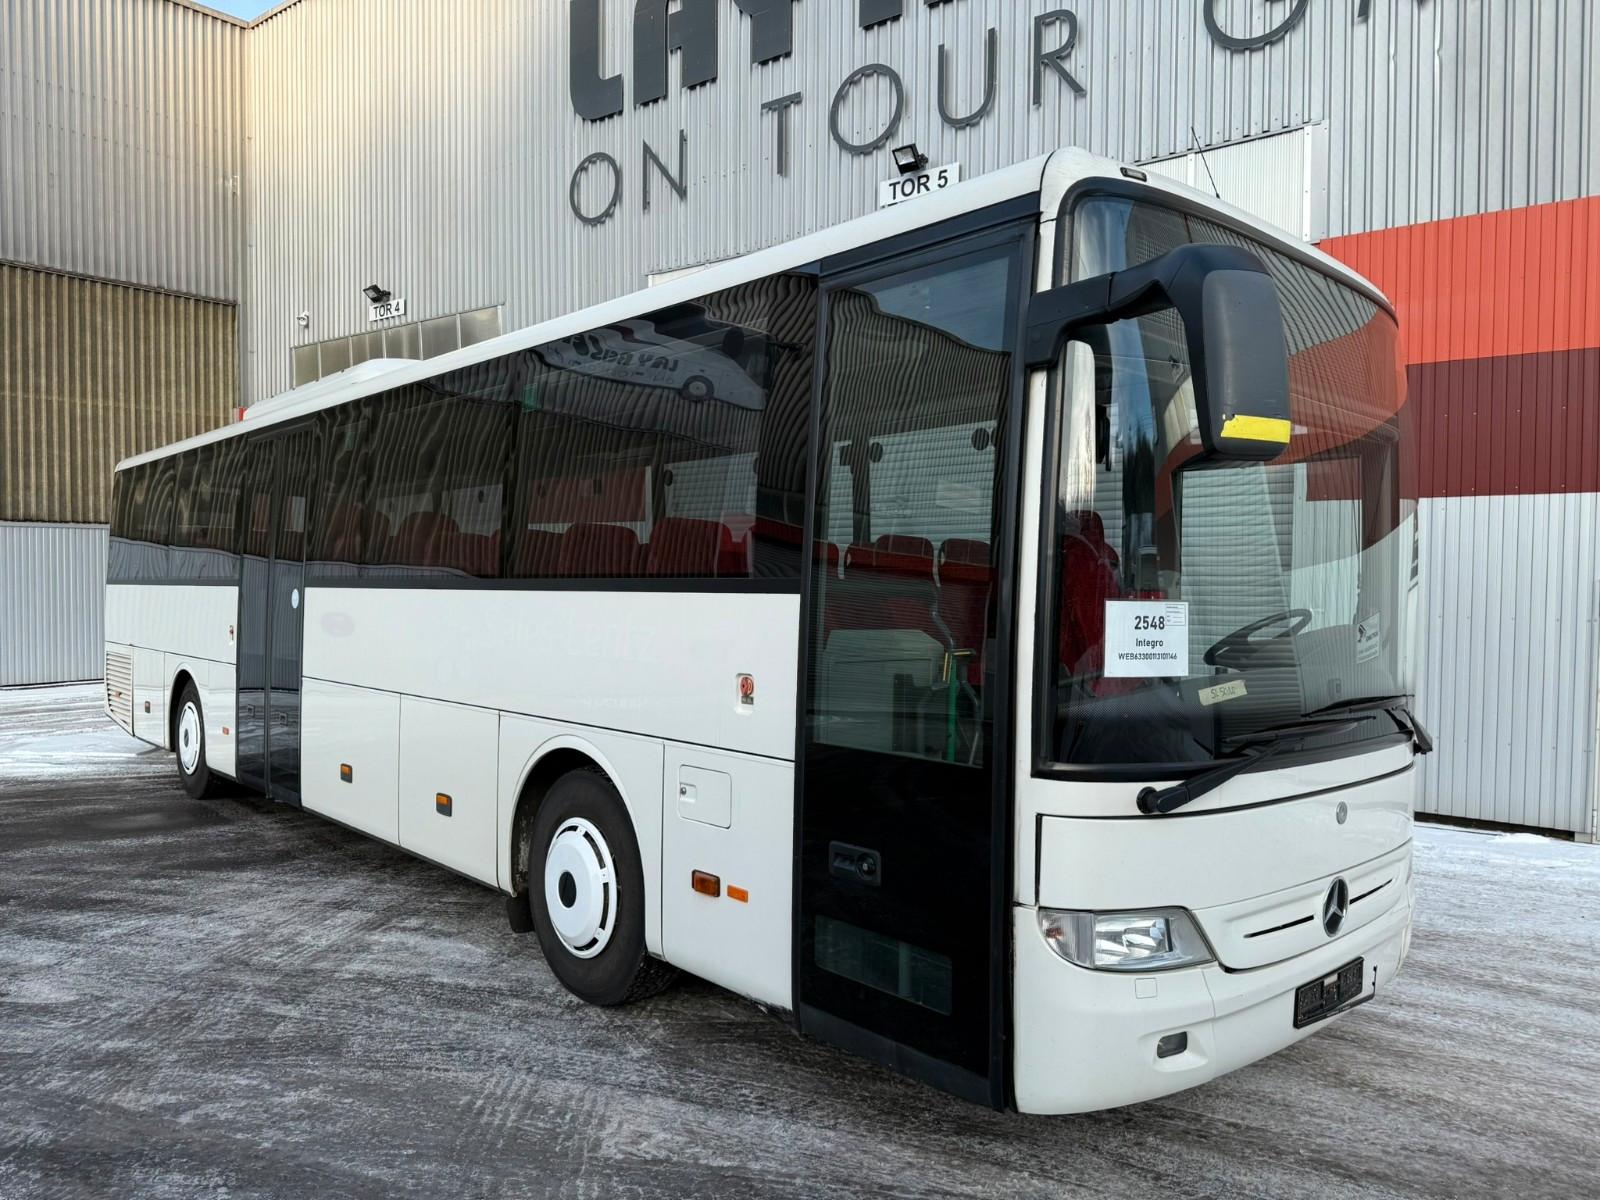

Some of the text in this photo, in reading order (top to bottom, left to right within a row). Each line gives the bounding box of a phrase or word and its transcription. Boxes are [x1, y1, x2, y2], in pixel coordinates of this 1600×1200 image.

[570, 9, 1086, 225] ON TOUR
[889, 169, 948, 200] TOR 5
[373, 300, 400, 319] TOR 4
[1134, 615, 1165, 630] 2548
[1135, 637, 1164, 649] Integro
